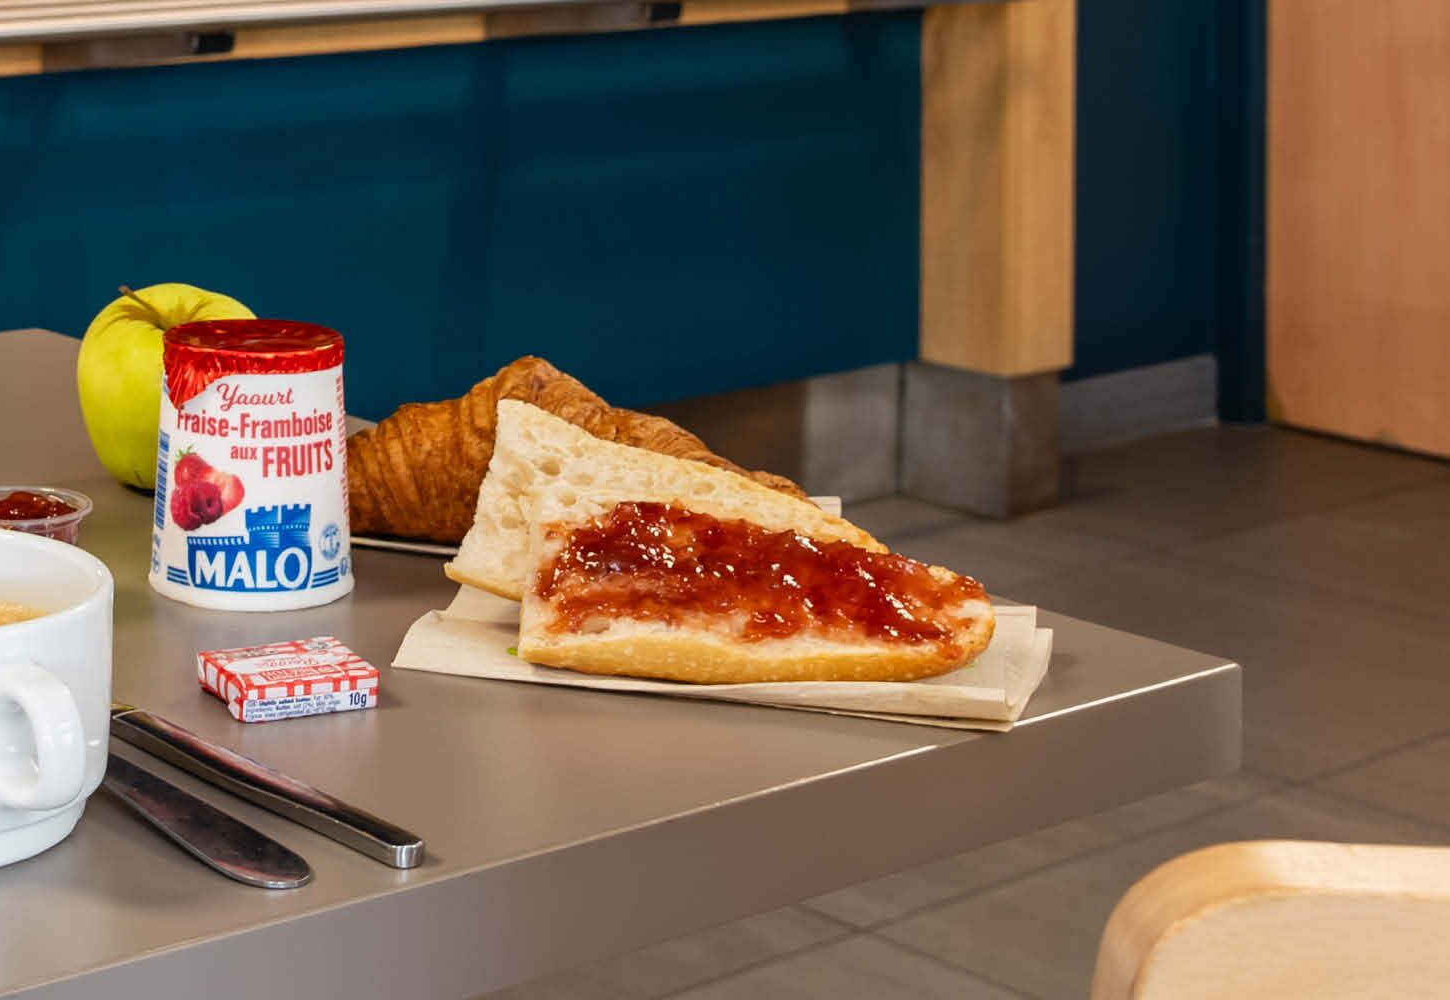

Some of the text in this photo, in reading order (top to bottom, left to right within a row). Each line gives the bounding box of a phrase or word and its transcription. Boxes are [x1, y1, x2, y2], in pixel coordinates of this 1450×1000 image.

[216, 383, 294, 411] Yaourt
[176, 407, 333, 439] Fraise-Framboise
[230, 438, 334, 478] aux FRUITS
[195, 547, 309, 589] MALO
[349, 691, 367, 708] 10g
